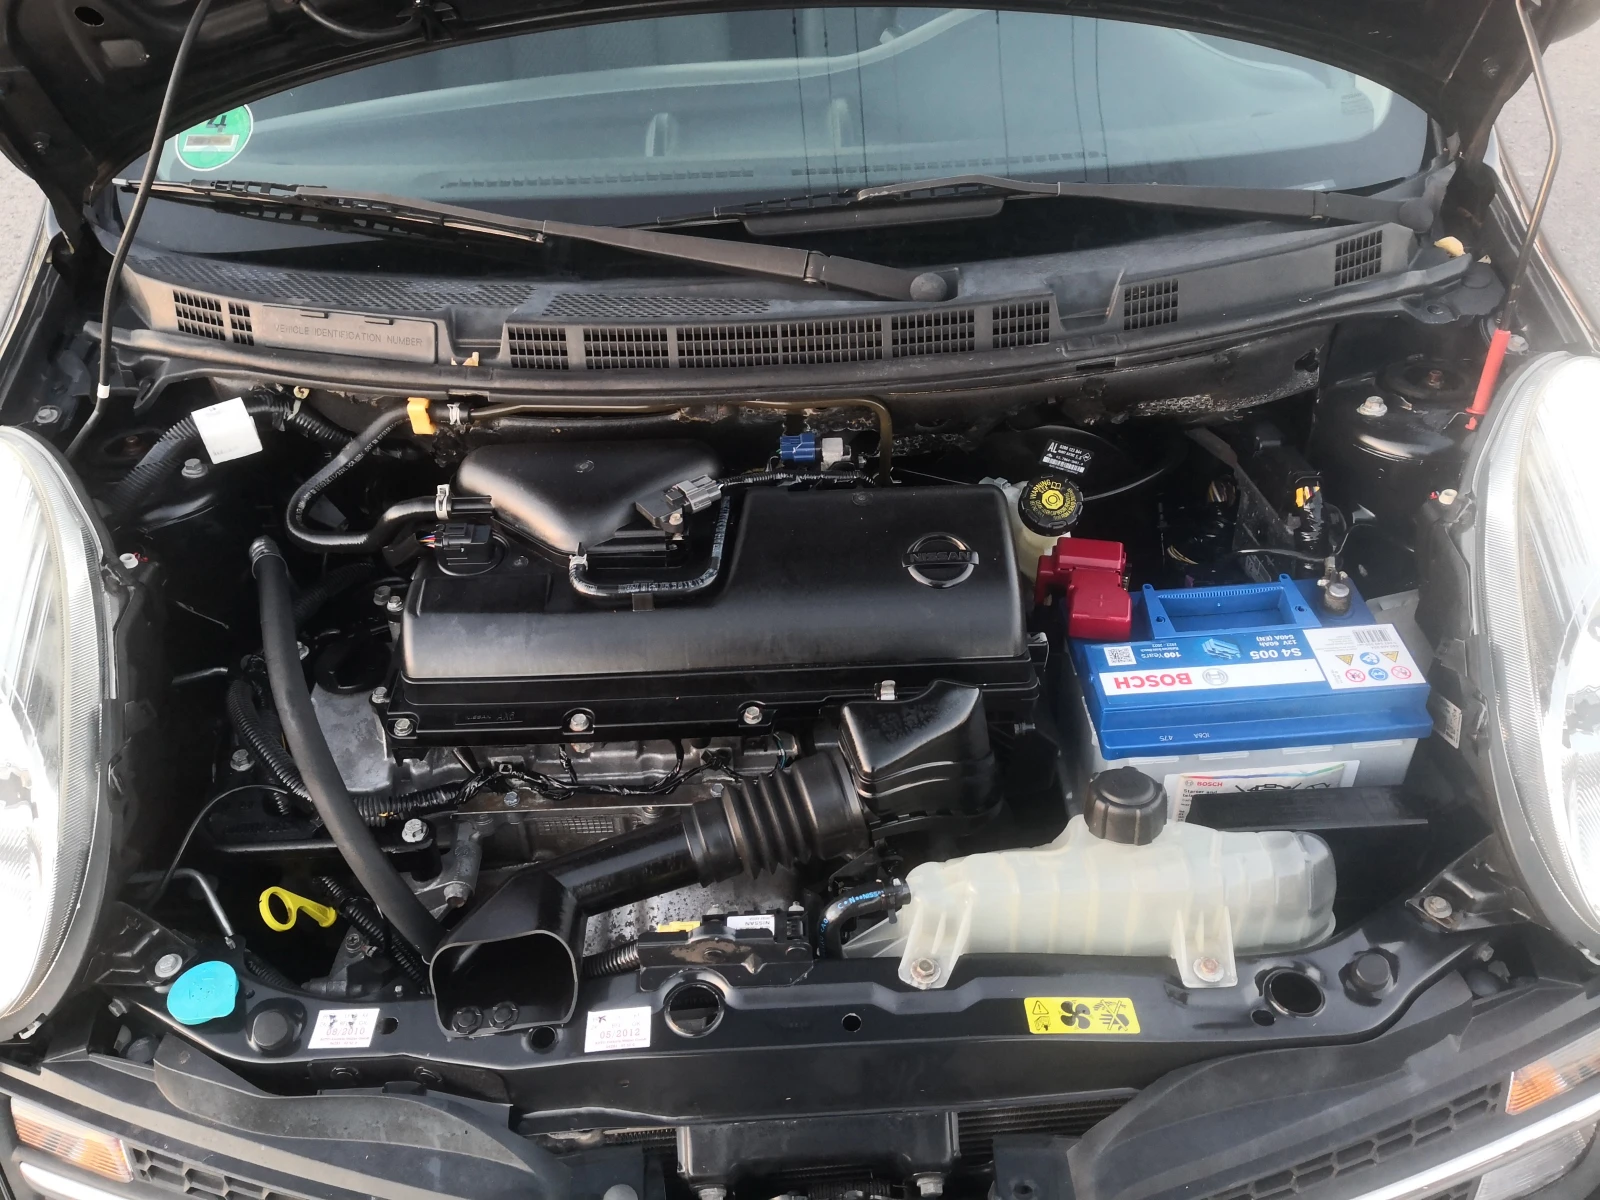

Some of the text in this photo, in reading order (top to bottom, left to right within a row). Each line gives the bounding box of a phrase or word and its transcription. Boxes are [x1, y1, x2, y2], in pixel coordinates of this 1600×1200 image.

[206, 114, 227, 132] 4
[274, 323, 423, 346] VEHICLE IDENTIFICATION NUMBER
[1047, 442, 1058, 453] AL
[1030, 479, 1051, 500] WARNING
[909, 551, 972, 563] NISSAN
[1249, 647, 1302, 660] S4 005
[1113, 672, 1193, 689] BOSCH
[599, 1027, 640, 1039] 05/2012
